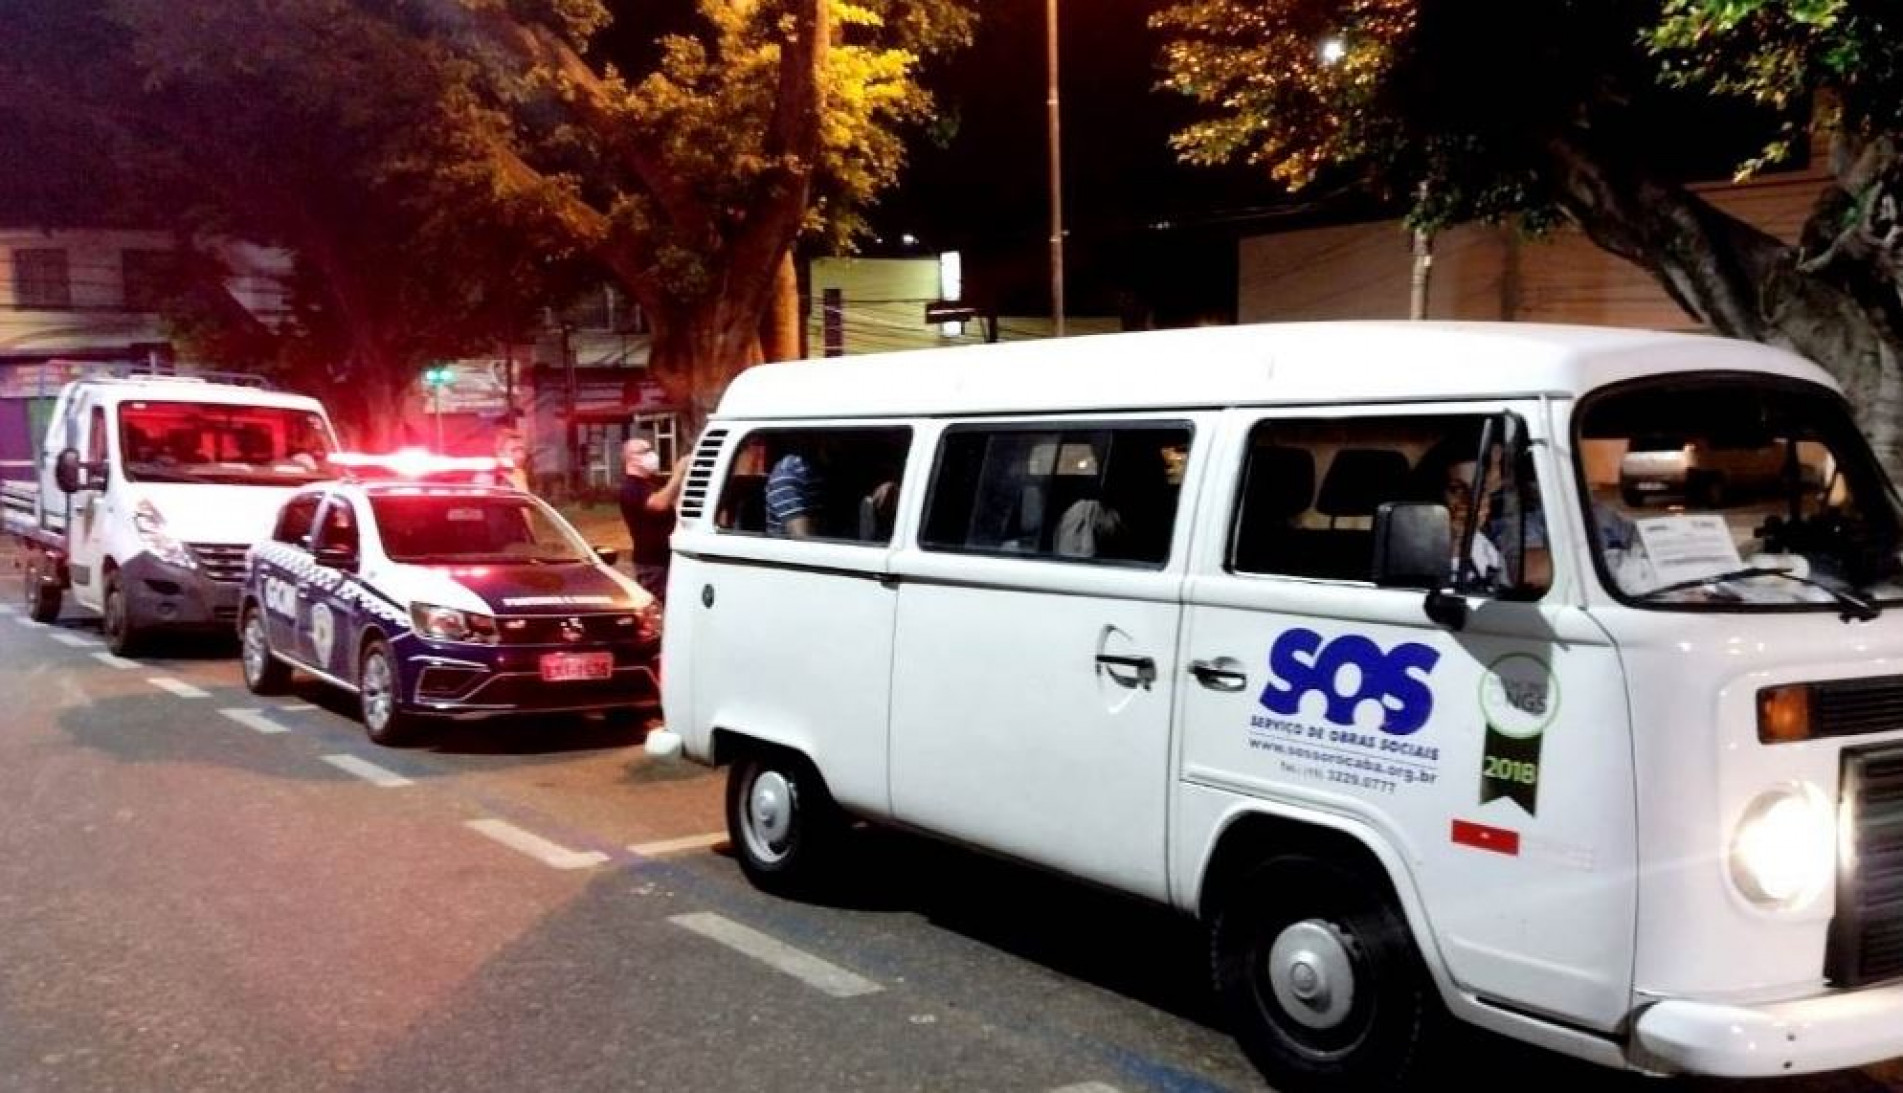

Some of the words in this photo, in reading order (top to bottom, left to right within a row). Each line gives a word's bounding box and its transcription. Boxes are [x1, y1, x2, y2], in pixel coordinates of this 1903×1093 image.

[1259, 627, 1441, 736] SOS
[1250, 715, 1303, 735] SERVIÇO
[1307, 726, 1324, 740] DE
[1328, 730, 1376, 748] OBRAS
[1380, 738, 1440, 761] SOCIAIS
[1484, 755, 1536, 784] 2018
